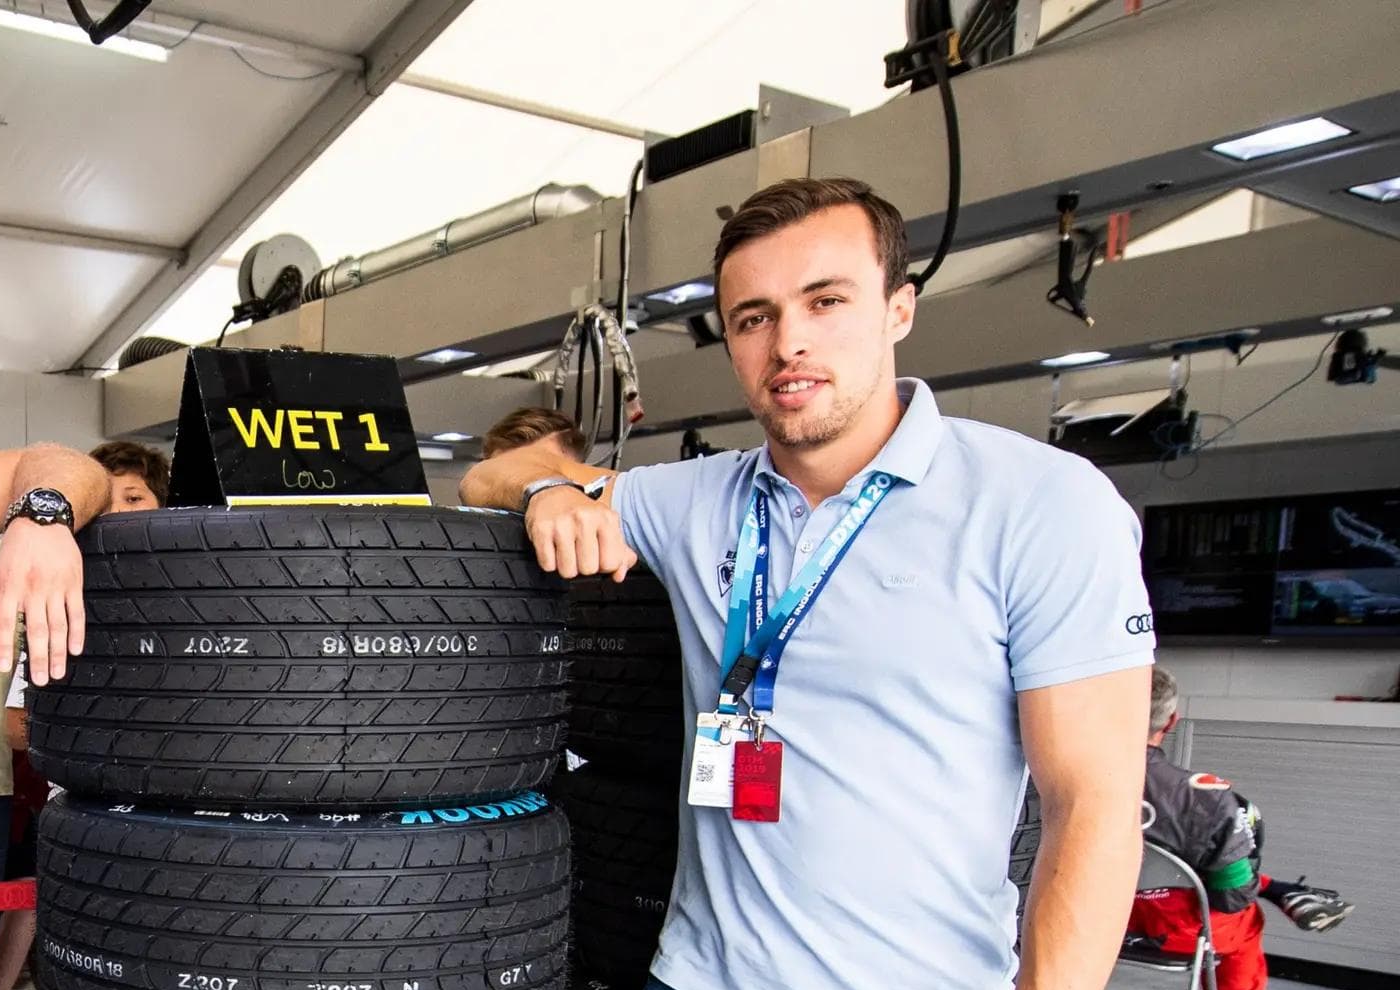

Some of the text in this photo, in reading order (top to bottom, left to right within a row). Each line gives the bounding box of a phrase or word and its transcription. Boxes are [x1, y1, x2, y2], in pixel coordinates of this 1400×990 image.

[227, 407, 390, 452] WET 1
[184, 633, 249, 655] Z207
